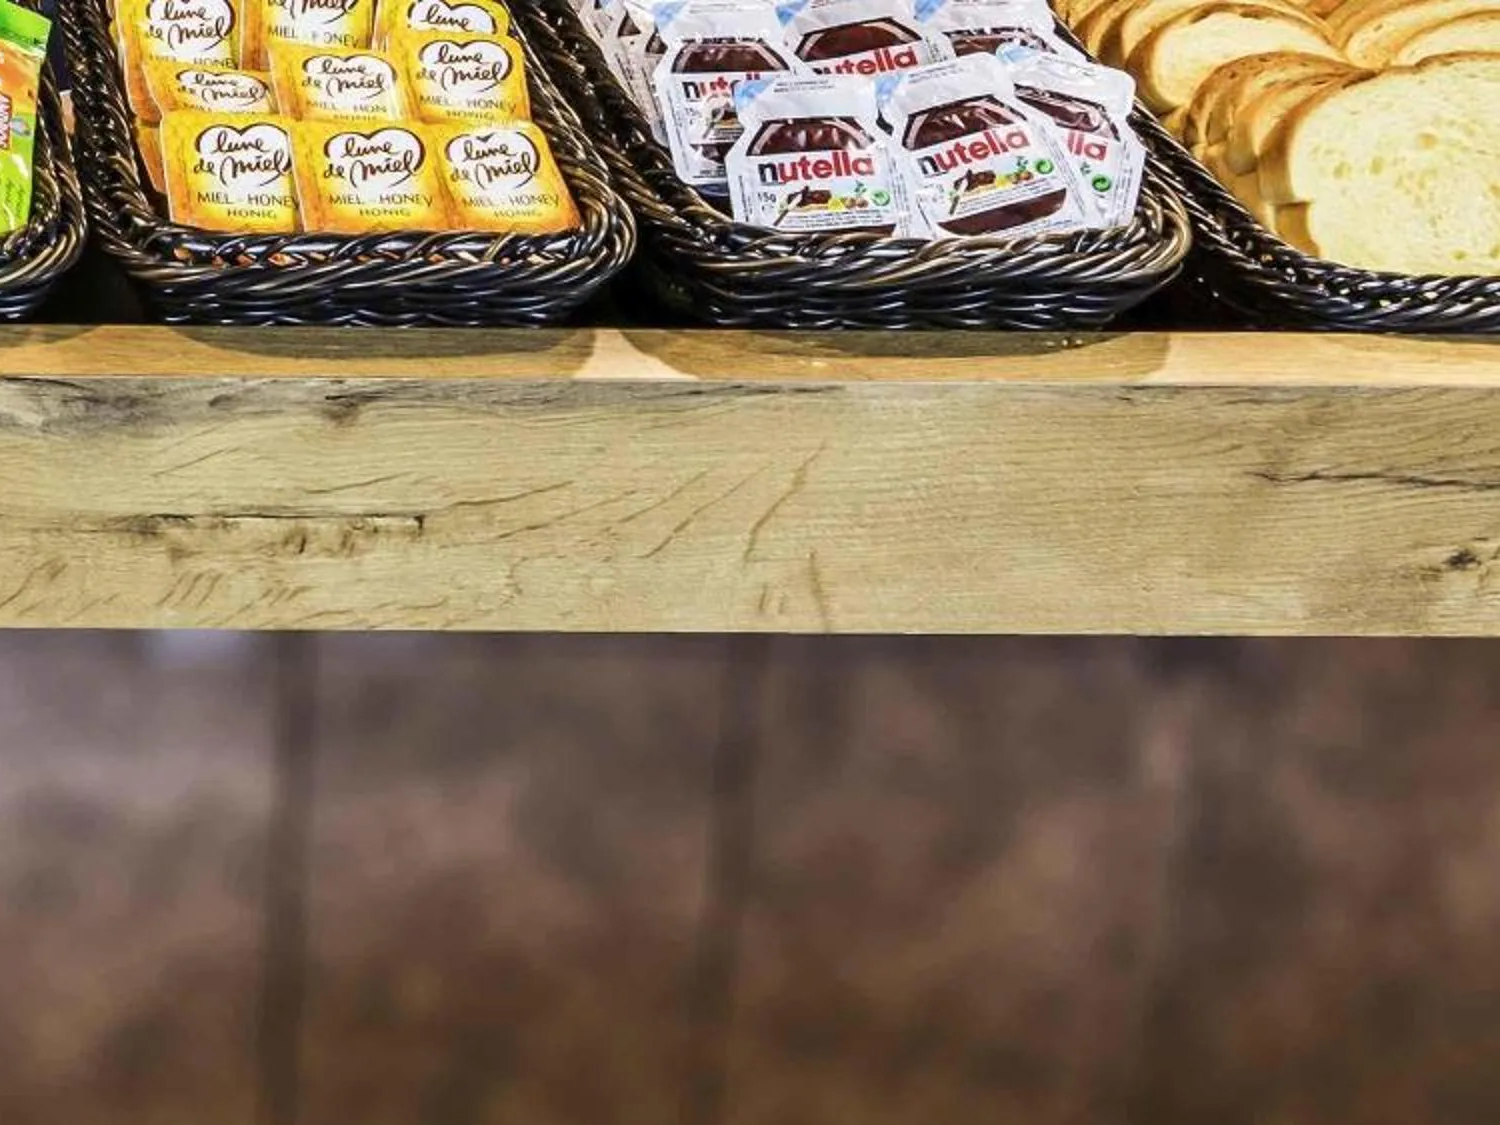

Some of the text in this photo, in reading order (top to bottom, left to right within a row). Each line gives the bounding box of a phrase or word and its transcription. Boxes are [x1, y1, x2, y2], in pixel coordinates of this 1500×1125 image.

[434, 44, 485, 64] lune
[441, 63, 504, 93] miel
[211, 130, 268, 154] lune
[341, 136, 397, 158] lune
[462, 139, 512, 162] lune
[918, 129, 1031, 175] nutella
[193, 150, 287, 187] de miel
[323, 150, 414, 189] de miel
[476, 152, 532, 189] miel
[757, 151, 875, 184] nutella
[197, 191, 233, 205] MIEL
[329, 193, 433, 208] MIEL HONEY
[509, 193, 559, 207] HONEY
